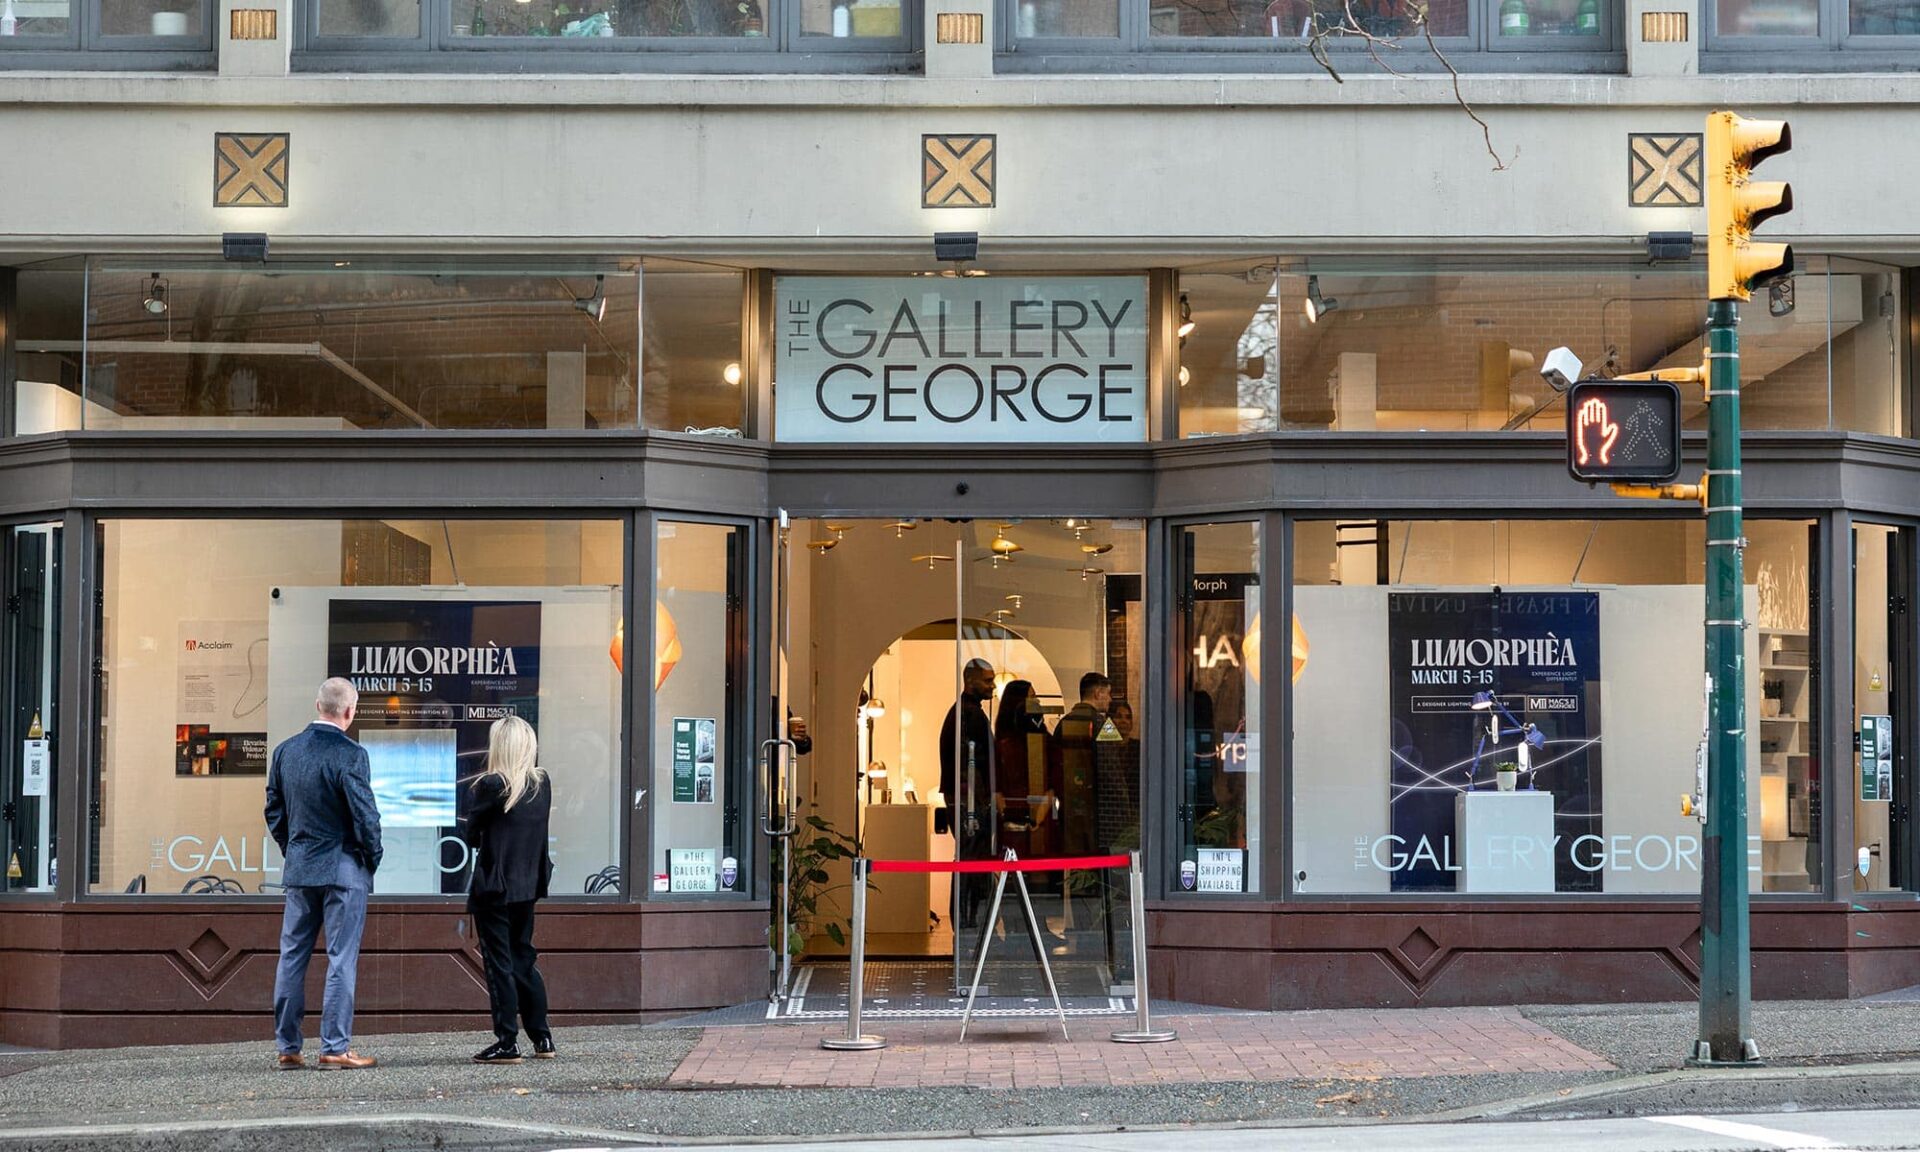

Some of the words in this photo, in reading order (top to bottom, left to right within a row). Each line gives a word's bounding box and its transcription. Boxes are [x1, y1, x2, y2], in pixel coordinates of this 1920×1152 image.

[789, 299, 810, 357] THE
[816, 298, 1133, 359] GALLERY
[816, 363, 1133, 423] GEORGE
[198, 641, 232, 650] Acclaim
[1411, 632, 1577, 667] LUMORPHÈA
[351, 640, 517, 675] LUMORPHÈA
[1411, 669, 1458, 684] MARCH
[350, 677, 397, 692] MARCH
[168, 835, 281, 873] GALL
[1354, 835, 1368, 870] THE
[1570, 834, 1761, 871] GEORE
[675, 866, 711, 876] GALLERY
[1200, 865, 1242, 876] SHIPPING
[676, 880, 707, 890] GEORGE
[1197, 880, 1240, 890] AVAILABLE
